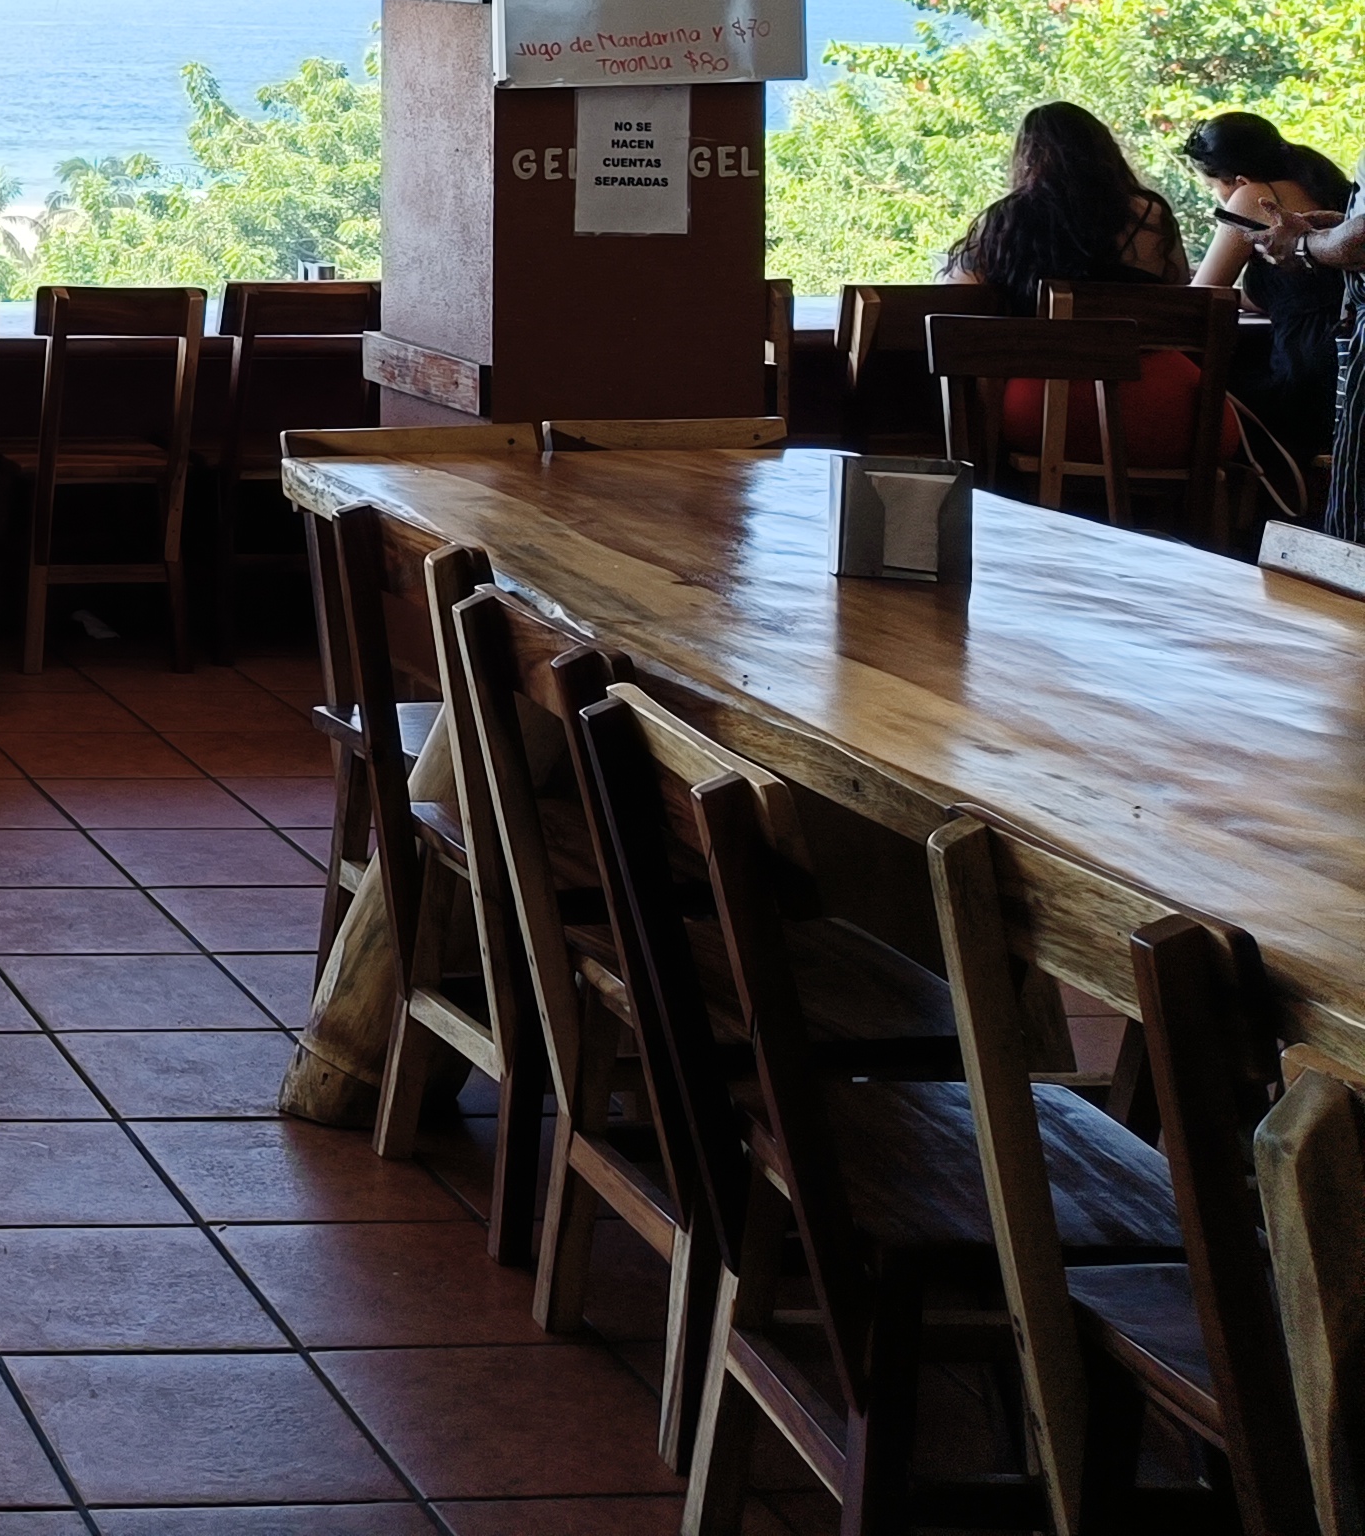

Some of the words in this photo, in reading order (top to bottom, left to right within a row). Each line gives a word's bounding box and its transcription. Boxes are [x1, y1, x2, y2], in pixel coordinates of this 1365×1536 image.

[569, 37, 595, 54] de
[596, 27, 702, 52] Mandarina
[731, 17, 770, 43] $70
[614, 122, 632, 132] NO
[636, 122, 652, 132] SE
[611, 139, 655, 150] HACEN
[602, 158, 662, 169] CUENTAS
[689, 145, 760, 178] GEL
[594, 176, 669, 188] SEPARADAS
